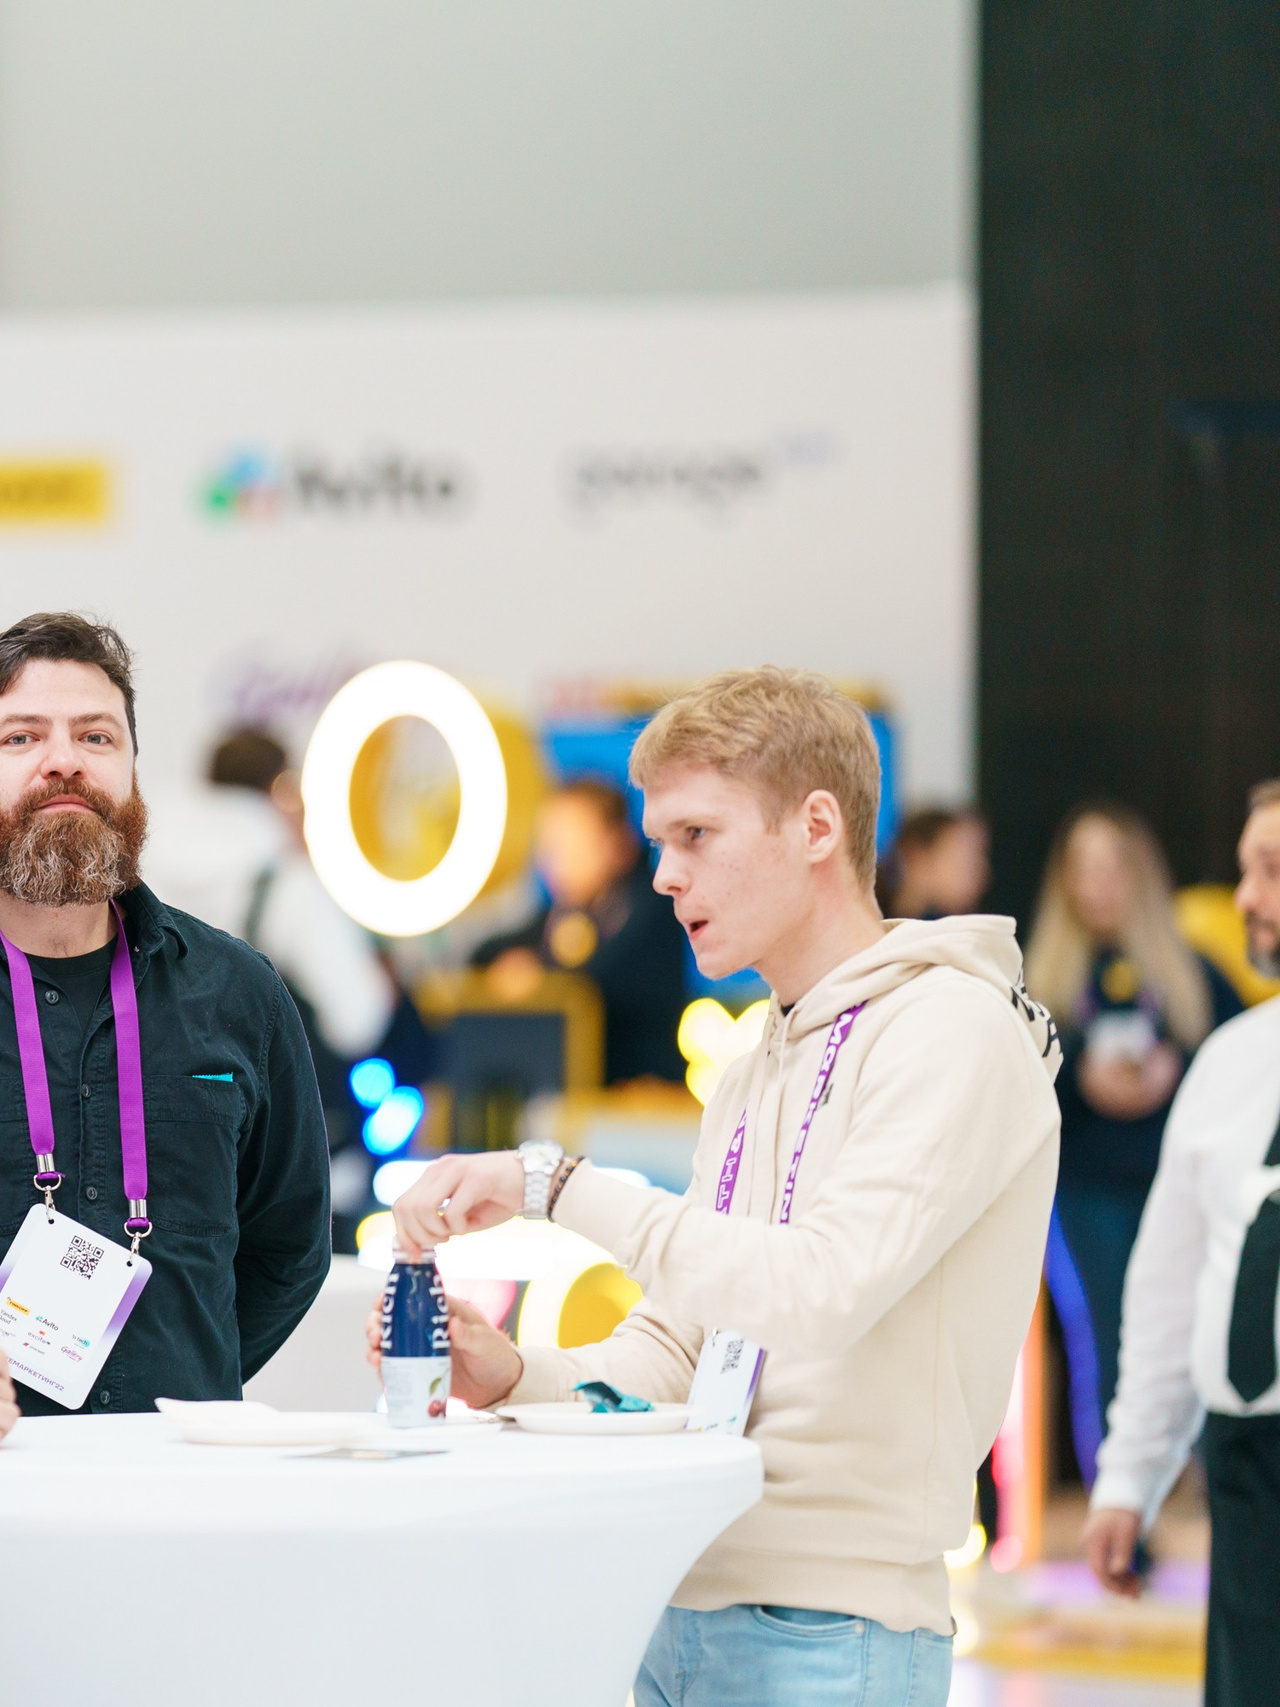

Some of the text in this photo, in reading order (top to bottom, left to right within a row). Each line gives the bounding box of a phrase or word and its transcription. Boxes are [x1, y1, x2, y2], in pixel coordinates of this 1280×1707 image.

[429, 1274, 450, 1349] Rich
[42, 1318, 59, 1331] Avito
[60, 1345, 83, 1362] Gallery
[7, 1357, 65, 1391] ЕМАРКЕТИНГ22
